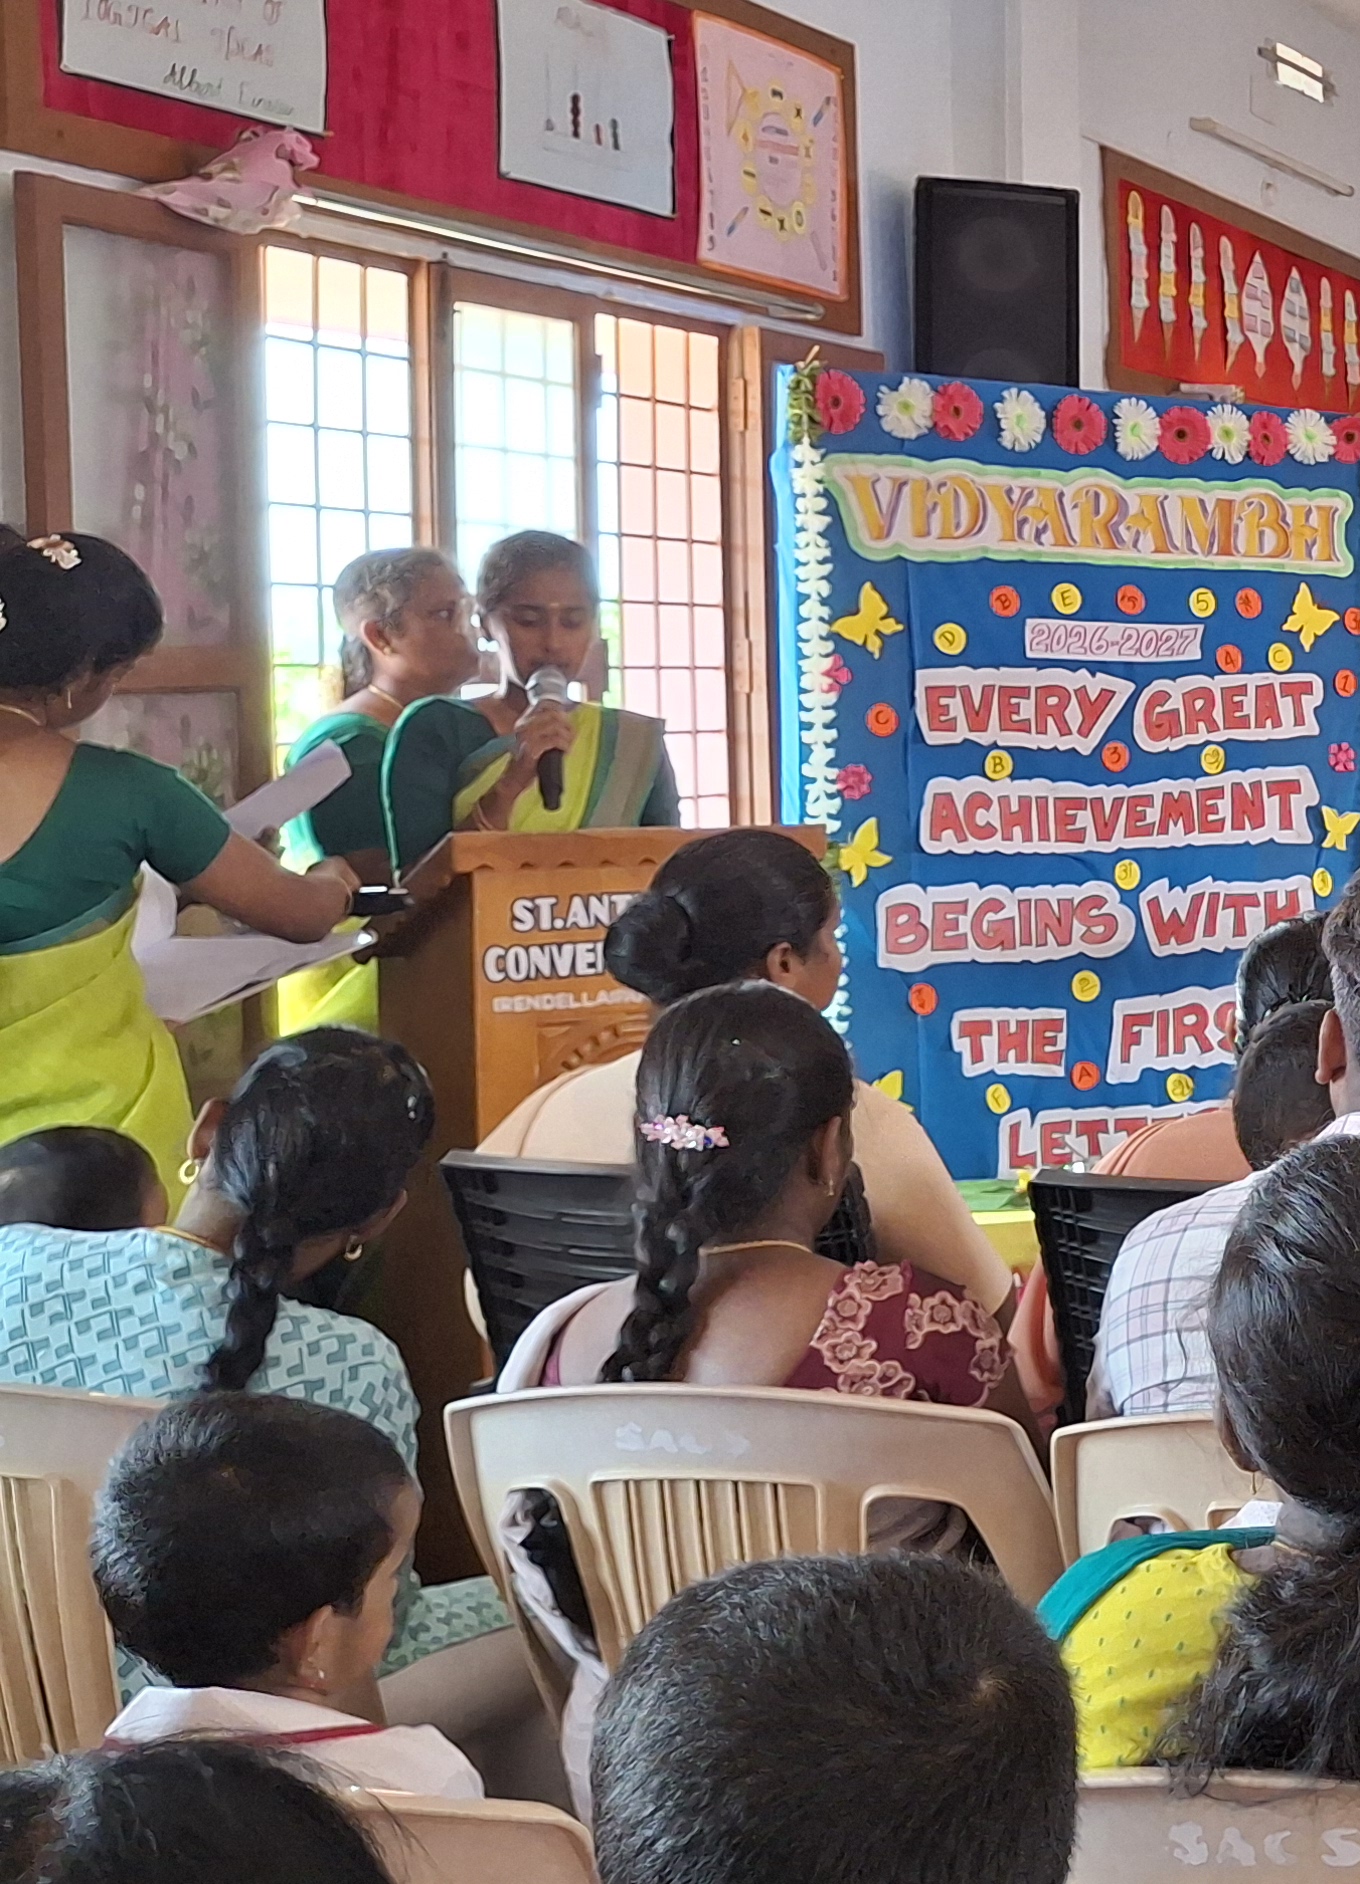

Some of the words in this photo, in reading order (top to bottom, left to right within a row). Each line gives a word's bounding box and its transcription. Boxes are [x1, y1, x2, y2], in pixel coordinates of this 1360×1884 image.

[845, 472, 1341, 562] VIDYARAMBH
[1060, 588, 1074, 608] E
[1029, 623, 1198, 659] 2026-2027
[924, 684, 1118, 740] EVERY
[1142, 681, 1315, 743] GREAT
[929, 778, 1302, 844] ACHIEVEMENT
[511, 892, 640, 932] ST.ANT
[885, 893, 1118, 956] BEGINS
[1146, 889, 1300, 946] WITH
[958, 1018, 1066, 1066] THE
[1120, 1002, 1236, 1064] FIRS
[1009, 1107, 1220, 1169] LETT
